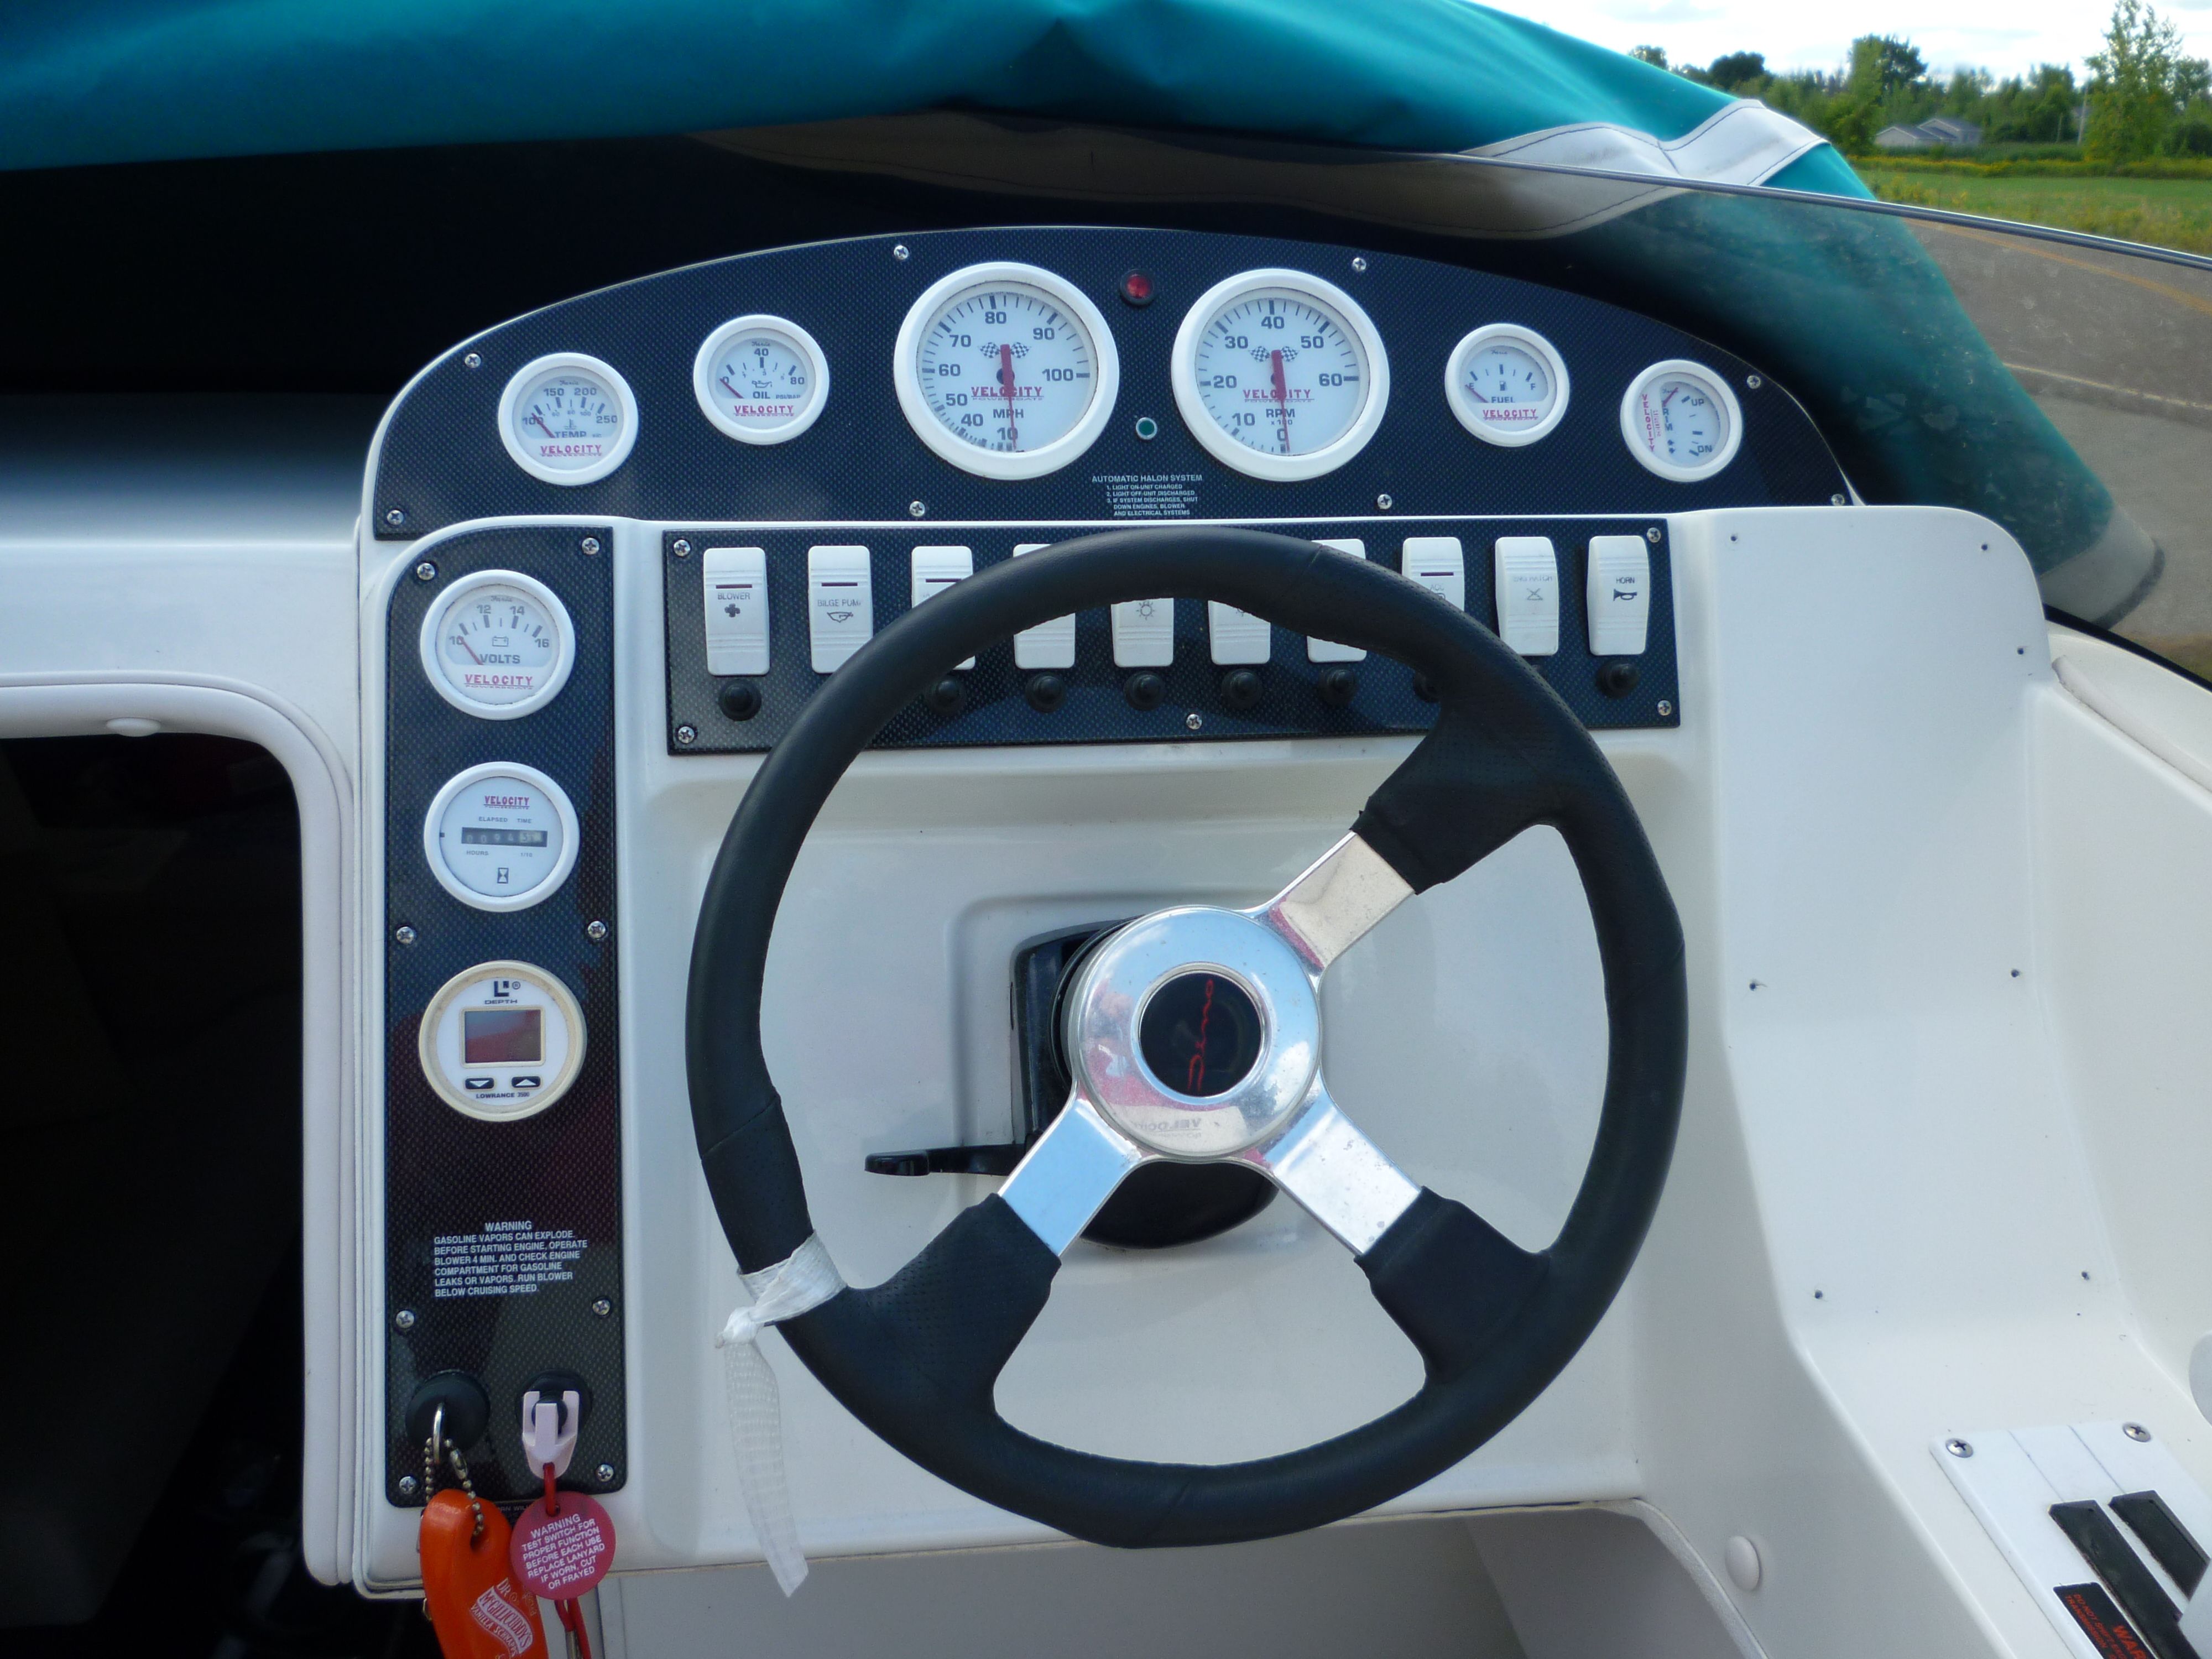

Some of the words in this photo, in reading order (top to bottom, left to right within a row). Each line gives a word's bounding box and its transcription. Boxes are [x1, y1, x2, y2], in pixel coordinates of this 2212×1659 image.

[985, 311, 1006, 325] 80
[1261, 316, 1285, 330] 40
[1034, 327, 1055, 340] 90
[950, 334, 971, 347] 70
[1225, 336, 1248, 349] 30
[1301, 336, 1324, 349] 50
[754, 348, 769, 356] 40
[939, 364, 961, 377] 60
[1042, 368, 1073, 381] 100
[790, 377, 805, 385] 80
[1213, 375, 1237, 388] 20
[1319, 373, 1343, 387] 60
[544, 388, 565, 396] 150
[574, 388, 597, 396] 200
[753, 391, 770, 399] OIL
[1243, 389, 1311, 398] VELOITY
[946, 393, 967, 406] 50
[734, 405, 794, 414] VELOCITY
[993, 409, 1024, 419] MPH
[1266, 408, 1296, 418] RPM
[1661, 400, 1673, 431] RIM
[522, 416, 544, 425] 100
[596, 415, 618, 424] 250
[961, 413, 983, 426] 40
[1232, 413, 1255, 426] 10
[1642, 394, 1655, 452] VELOCITY
[997, 427, 1019, 441] 10
[540, 445, 602, 454] VELOCITY
[477, 604, 491, 614] 12
[510, 606, 525, 615] 14
[448, 635, 465, 645] 10
[534, 638, 549, 648] 16
[479, 654, 520, 664] VOLTS
[465, 674, 533, 685] VELOCITY
[484, 795, 529, 806] VELOCITY
[485, 1220, 532, 1232] WARNING
[434, 1234, 477, 1244] GASOLINE
[479, 1233, 513, 1242] VAPORS
[515, 1232, 533, 1240] CAN
[535, 1230, 575, 1239] EXPLODE.
[434, 1245, 469, 1255] BEFORE
[471, 1243, 512, 1253] STARTING
[514, 1241, 547, 1251] ENGINE,
[549, 1239, 588, 1249] OPERATE
[434, 1256, 471, 1265] BLOWER
[479, 1255, 497, 1263] MIN.
[499, 1254, 517, 1262] AND
[519, 1252, 547, 1261] CHECK
[549, 1250, 581, 1260] ENGINE
[435, 1265, 499, 1276] COMPARTMENT
[501, 1264, 518, 1272] FOR
[520, 1261, 562, 1271] GASOLINE
[435, 1277, 463, 1286] LEAKS
[465, 1276, 477, 1285] OR
[479, 1274, 516, 1284] VAPORS.
[518, 1274, 535, 1282] RUN
[537, 1271, 573, 1281] BLOWER
[435, 1287, 466, 1297] BELOW
[467, 1285, 508, 1295] CRUISING
[530, 1513, 581, 1539] WARNING
[521, 1538, 542, 1552] TEST
[544, 1525, 576, 1543] SWITCH
[578, 1518, 596, 1531] FOR
[523, 1543, 556, 1561] PROPER
[557, 1526, 599, 1548] FUNCTION
[526, 1551, 559, 1569] BEFORE
[560, 1542, 583, 1556] EACH
[585, 1535, 602, 1547] USE
[528, 1558, 566, 1578] REPLACE
[566, 1543, 605, 1563] LANYARD
[541, 1574, 549, 1583] IF
[551, 1563, 579, 1579] WORN,
[581, 1555, 596, 1567] CUT
[548, 1579, 561, 1589] OR
[562, 1566, 595, 1584] FRAYED
[496, 1577, 512, 1598] DR
[470, 1603, 494, 1629] VANILLA
[494, 1625, 518, 1657] SCHNAPPS
